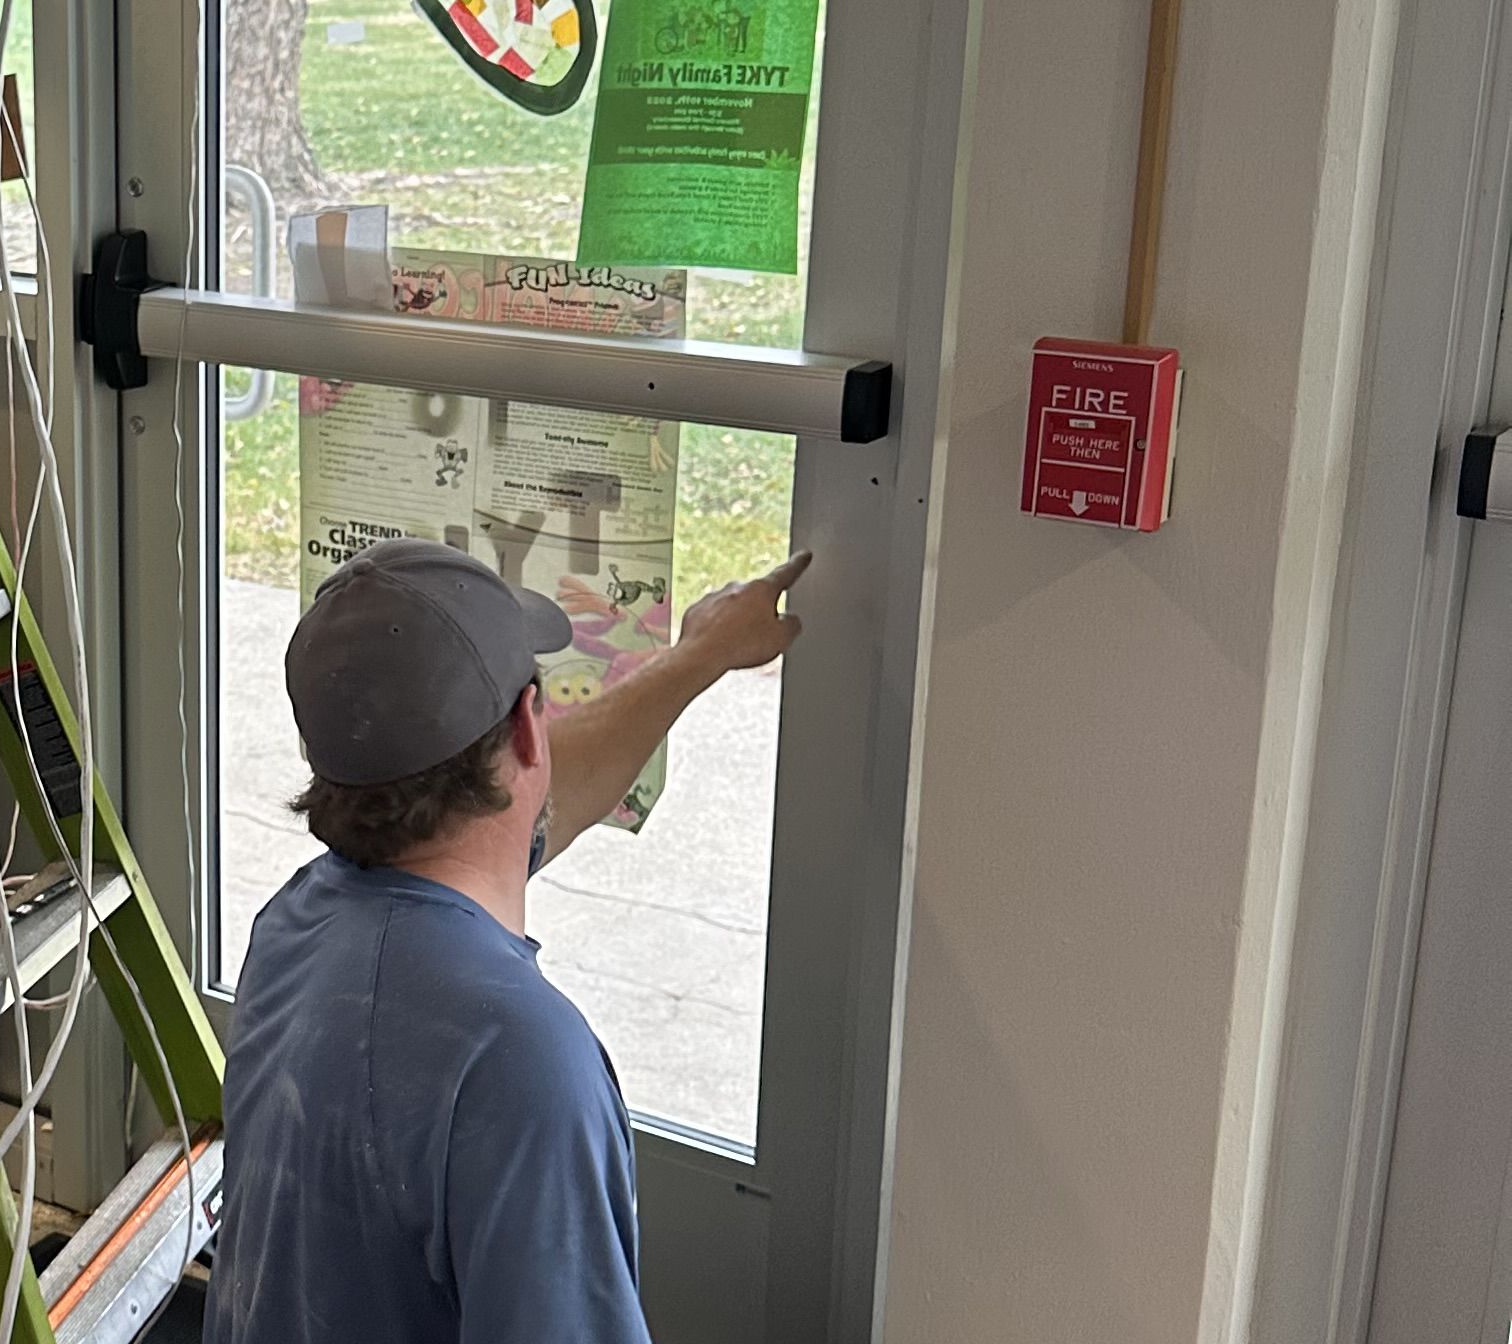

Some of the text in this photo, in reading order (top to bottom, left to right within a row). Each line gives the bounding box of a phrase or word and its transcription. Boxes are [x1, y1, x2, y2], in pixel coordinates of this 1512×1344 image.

[400, 268, 446, 283] Learning!
[1072, 360, 1114, 373] SIEMENS
[1051, 385, 1129, 414] FIRE
[1052, 434, 1121, 452] PUSH HERE
[1069, 447, 1101, 460] THEN
[1040, 485, 1120, 506] PULL DOWN
[349, 521, 402, 538] TREND
